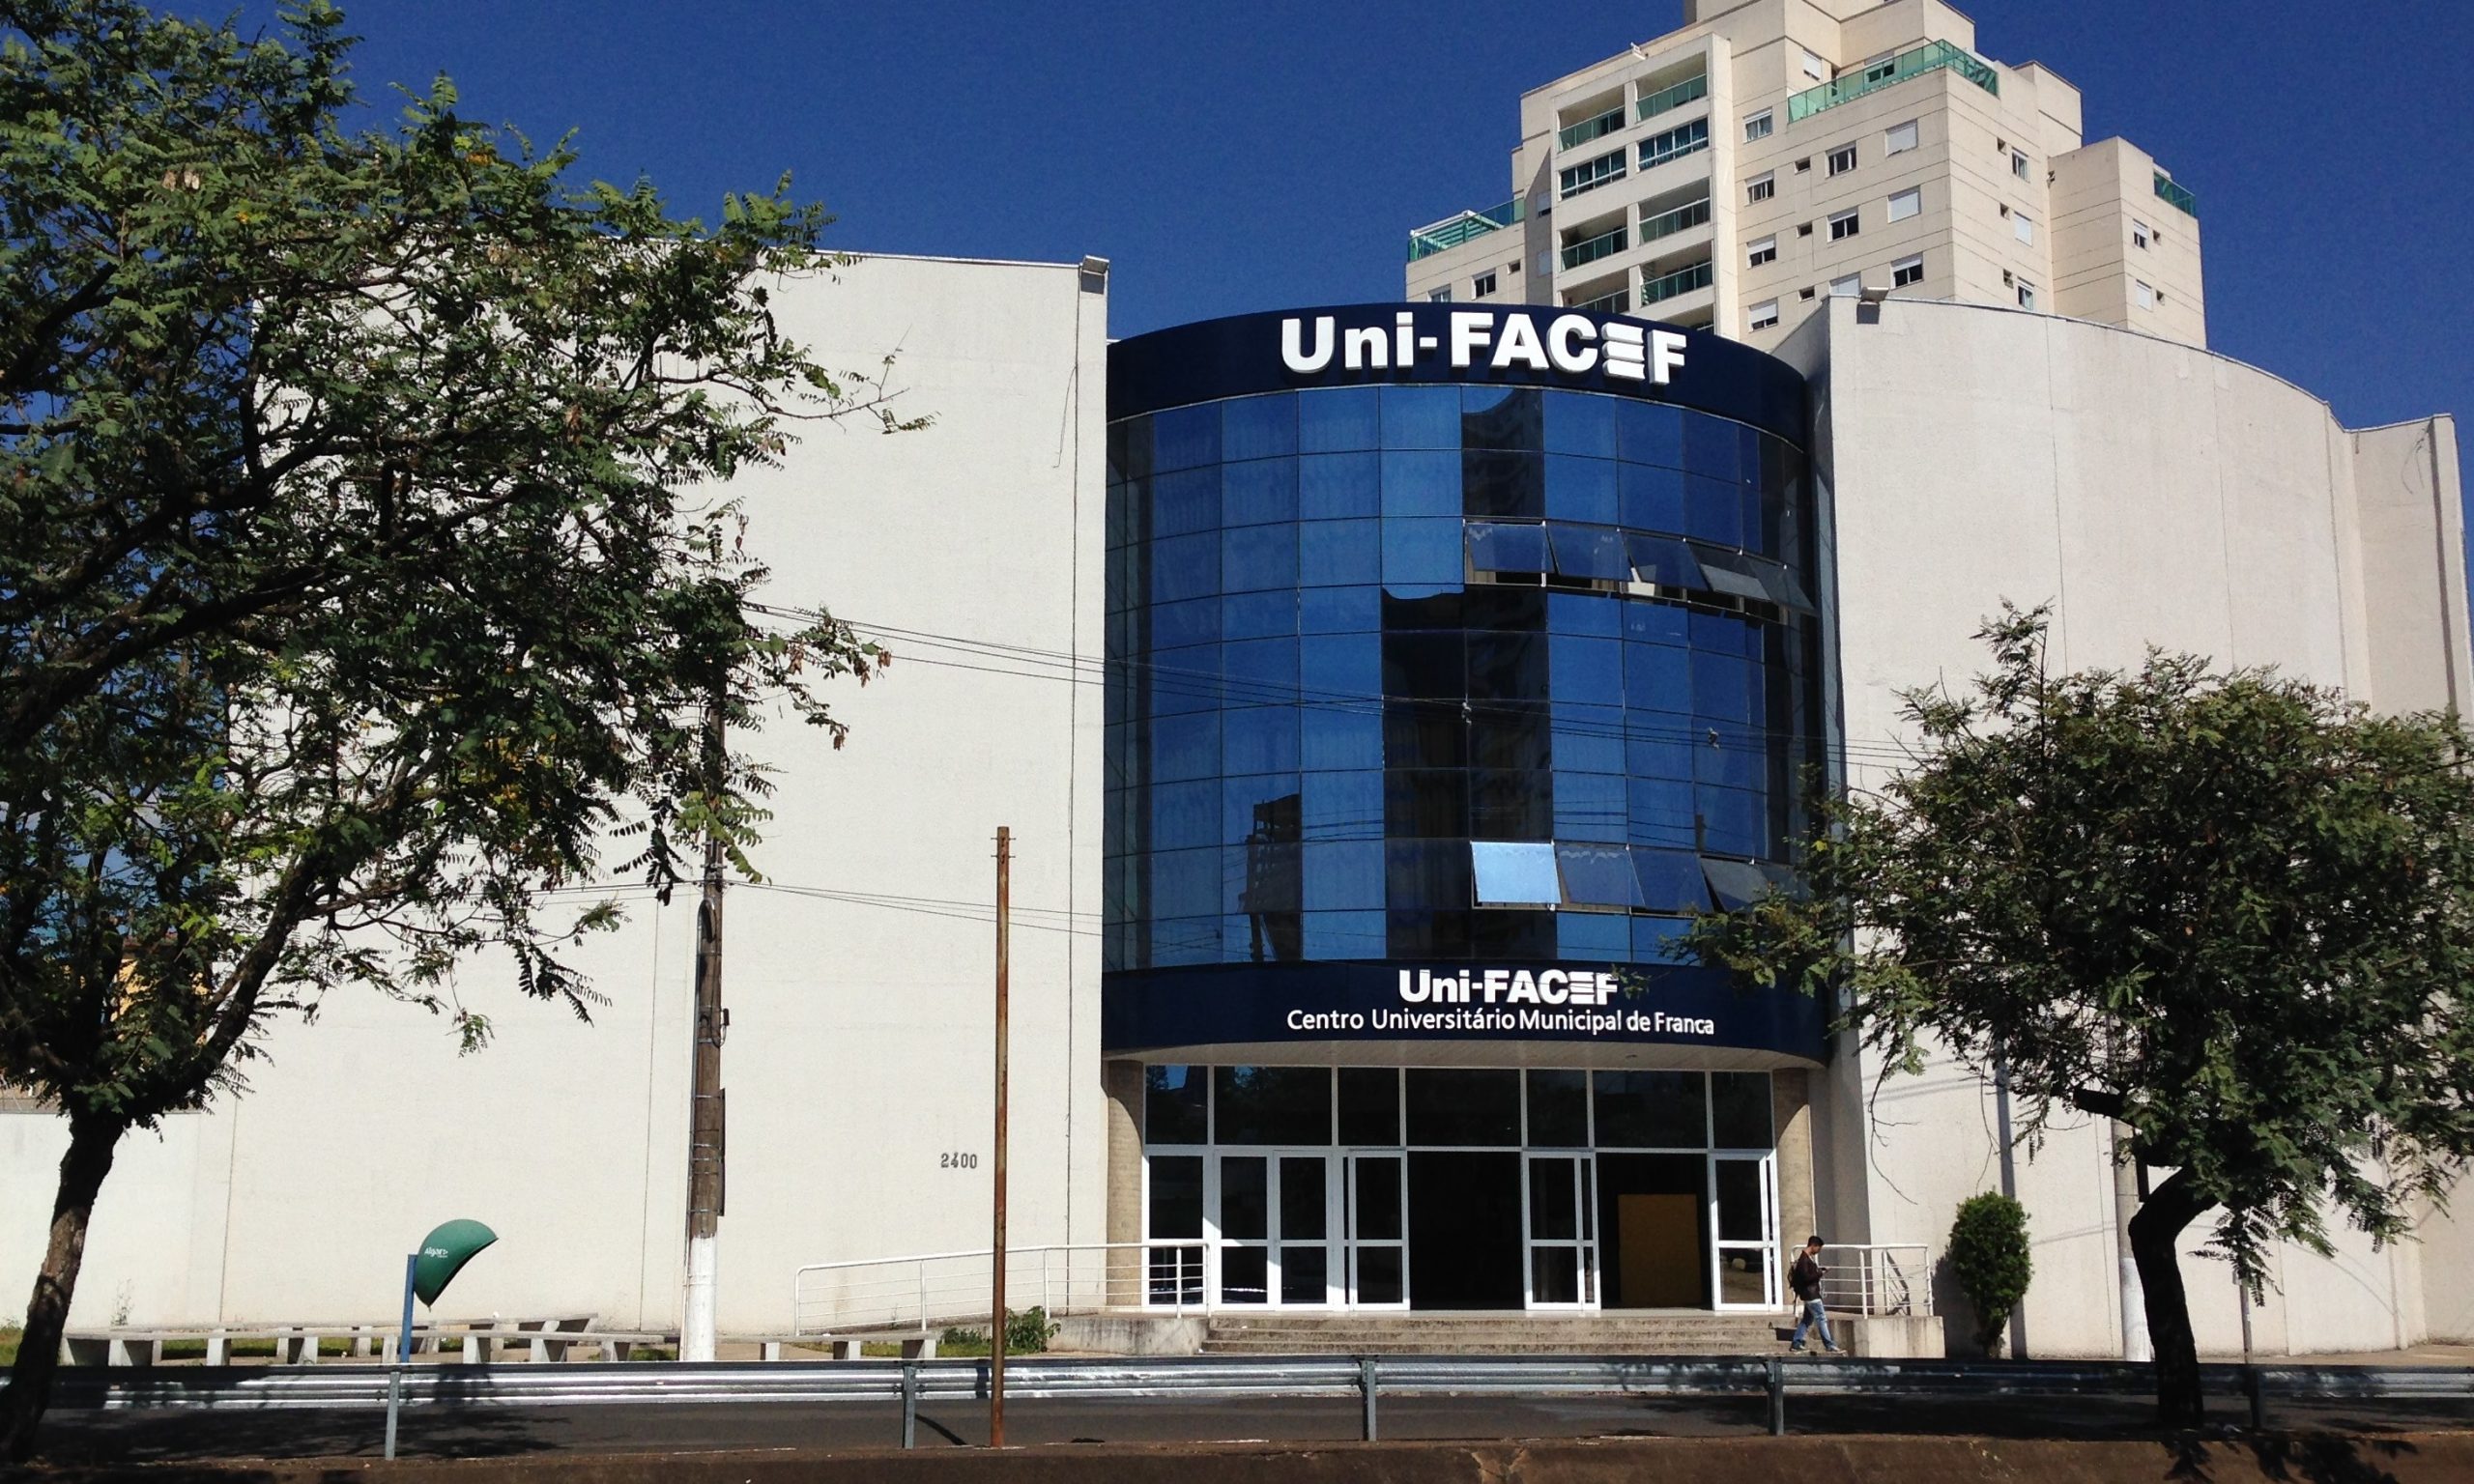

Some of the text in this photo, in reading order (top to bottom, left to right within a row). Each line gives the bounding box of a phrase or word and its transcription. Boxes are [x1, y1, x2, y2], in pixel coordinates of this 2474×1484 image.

[1281, 311, 1686, 385] Uni-FACEF
[1287, 1007, 1714, 1036] Centro Universitário Municipal de Franca
[940, 1152, 977, 1169] 2400
